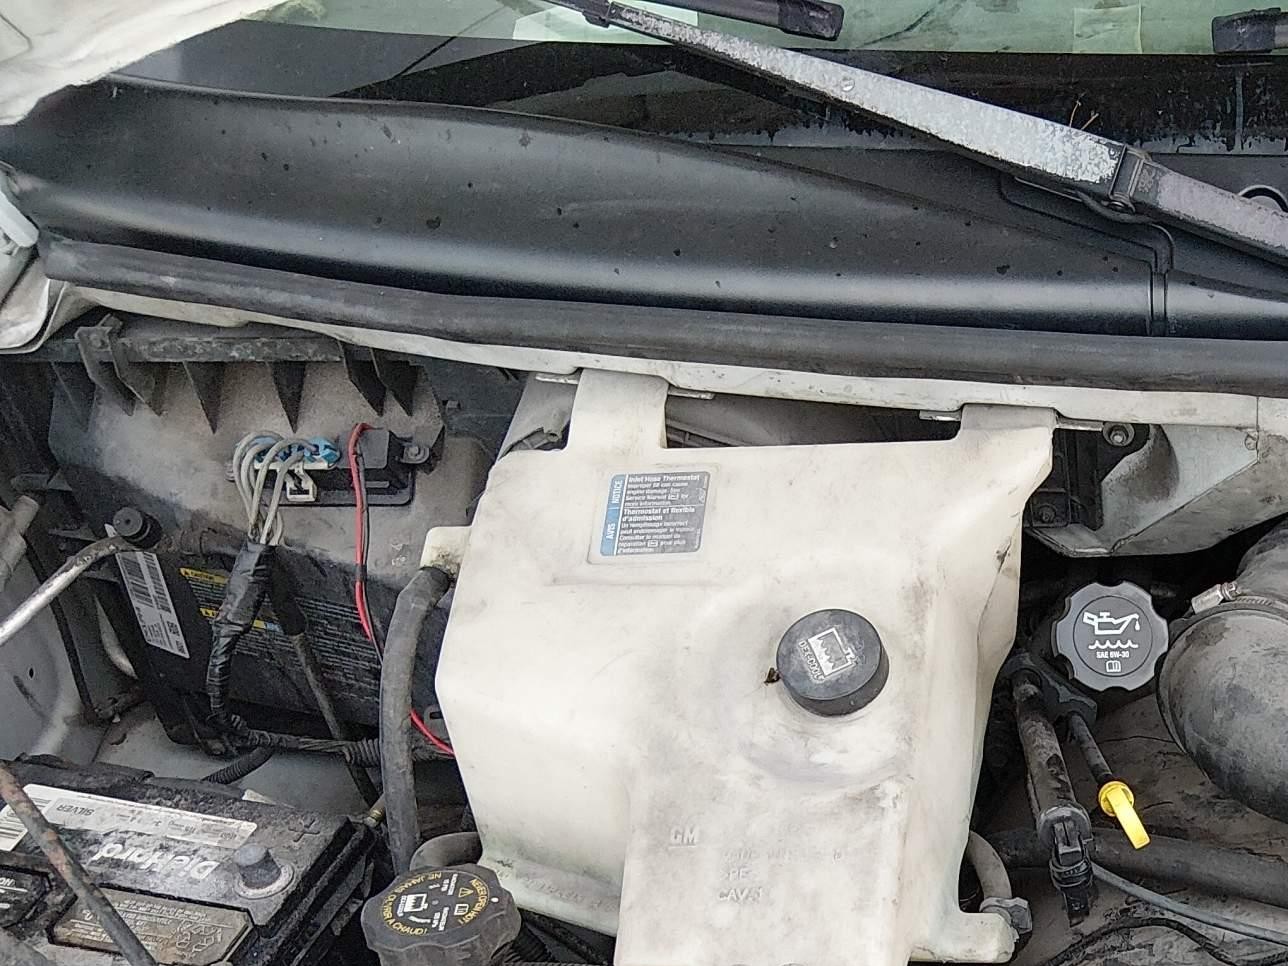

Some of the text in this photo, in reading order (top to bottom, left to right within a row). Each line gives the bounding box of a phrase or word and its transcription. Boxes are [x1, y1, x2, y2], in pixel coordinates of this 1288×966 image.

[611, 480, 623, 503] NOTICE
[606, 523, 616, 540] AVIS
[1096, 651, 1109, 659] SAE
[56, 802, 94, 816] SILVER
[670, 829, 698, 846] GM
[88, 842, 220, 880] DieHard
[427, 872, 442, 880] NE
[470, 878, 487, 896] NEVER
[474, 895, 487, 913] OPEN
[392, 922, 428, 936] CHAUD!
